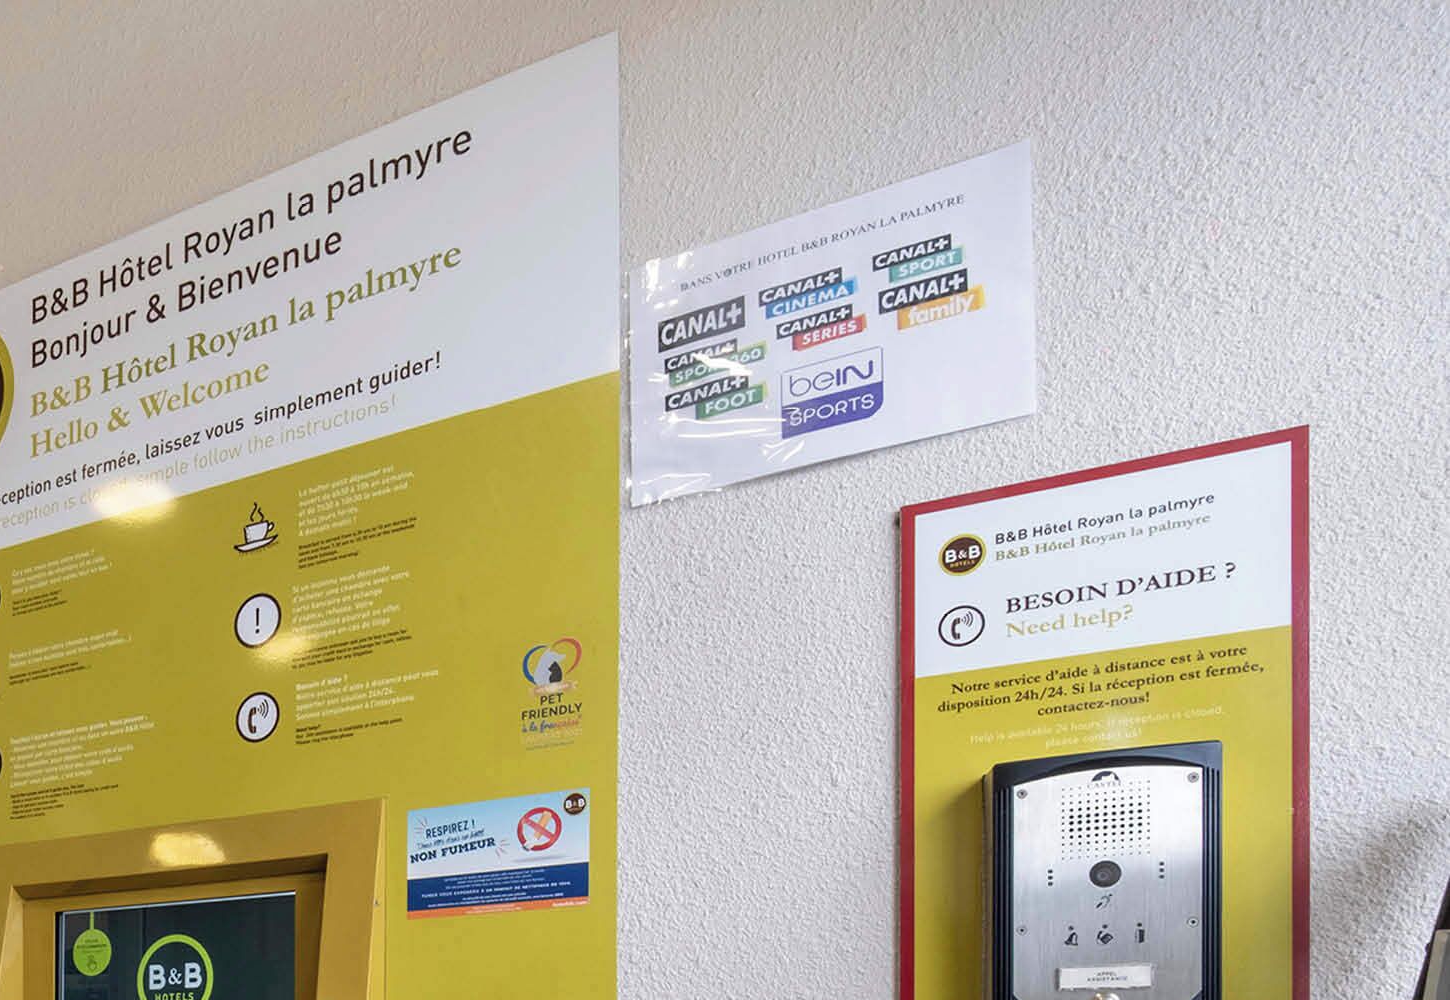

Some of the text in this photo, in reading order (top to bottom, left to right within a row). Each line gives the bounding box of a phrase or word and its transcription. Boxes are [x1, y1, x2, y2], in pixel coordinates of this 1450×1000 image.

[32, 129, 473, 325] B&B Hôtel Royan la palmyre
[757, 246, 799, 266] HOTEL
[801, 236, 829, 253] B&B
[831, 221, 877, 243] ROYAN
[879, 215, 897, 228] LA
[900, 193, 966, 221] PALMYRE
[875, 235, 949, 269] CANAL+
[898, 251, 957, 279] SPORT
[31, 230, 343, 369] Bonjour & Bienvenue
[760, 269, 839, 303] CANAL+
[772, 285, 849, 316] CINEMA
[881, 272, 966, 310] CANAL+
[661, 302, 743, 347] CANAL+
[779, 306, 850, 337] CANAL+
[907, 293, 976, 327] family
[801, 320, 859, 346] SERIES
[668, 376, 746, 409] CANAL+
[704, 389, 757, 415] FOOT
[789, 393, 875, 426] SPORTS
[29, 361, 270, 459] Hello & Welcome
[55, 468, 78, 489] est
[81, 449, 141, 481] fermée,
[145, 431, 201, 461] laissez
[205, 416, 245, 442] vous
[253, 376, 363, 426] simplement
[369, 350, 442, 395] guider!
[995, 493, 1215, 545] B&B Hôtel Royan la palmyre
[944, 544, 981, 563] B&B
[1006, 564, 1216, 614] BESOIN D'AIDE
[1006, 604, 1133, 638] Need help?
[951, 646, 1247, 694] Notre service d'aide à distance est à votre
[521, 702, 583, 721] FRIENDLY
[540, 692, 563, 705] PET
[425, 821, 470, 839] RESPIREZ
[410, 849, 438, 865] NON
[440, 836, 497, 858] FUMEUR
[148, 961, 202, 990] B&B
